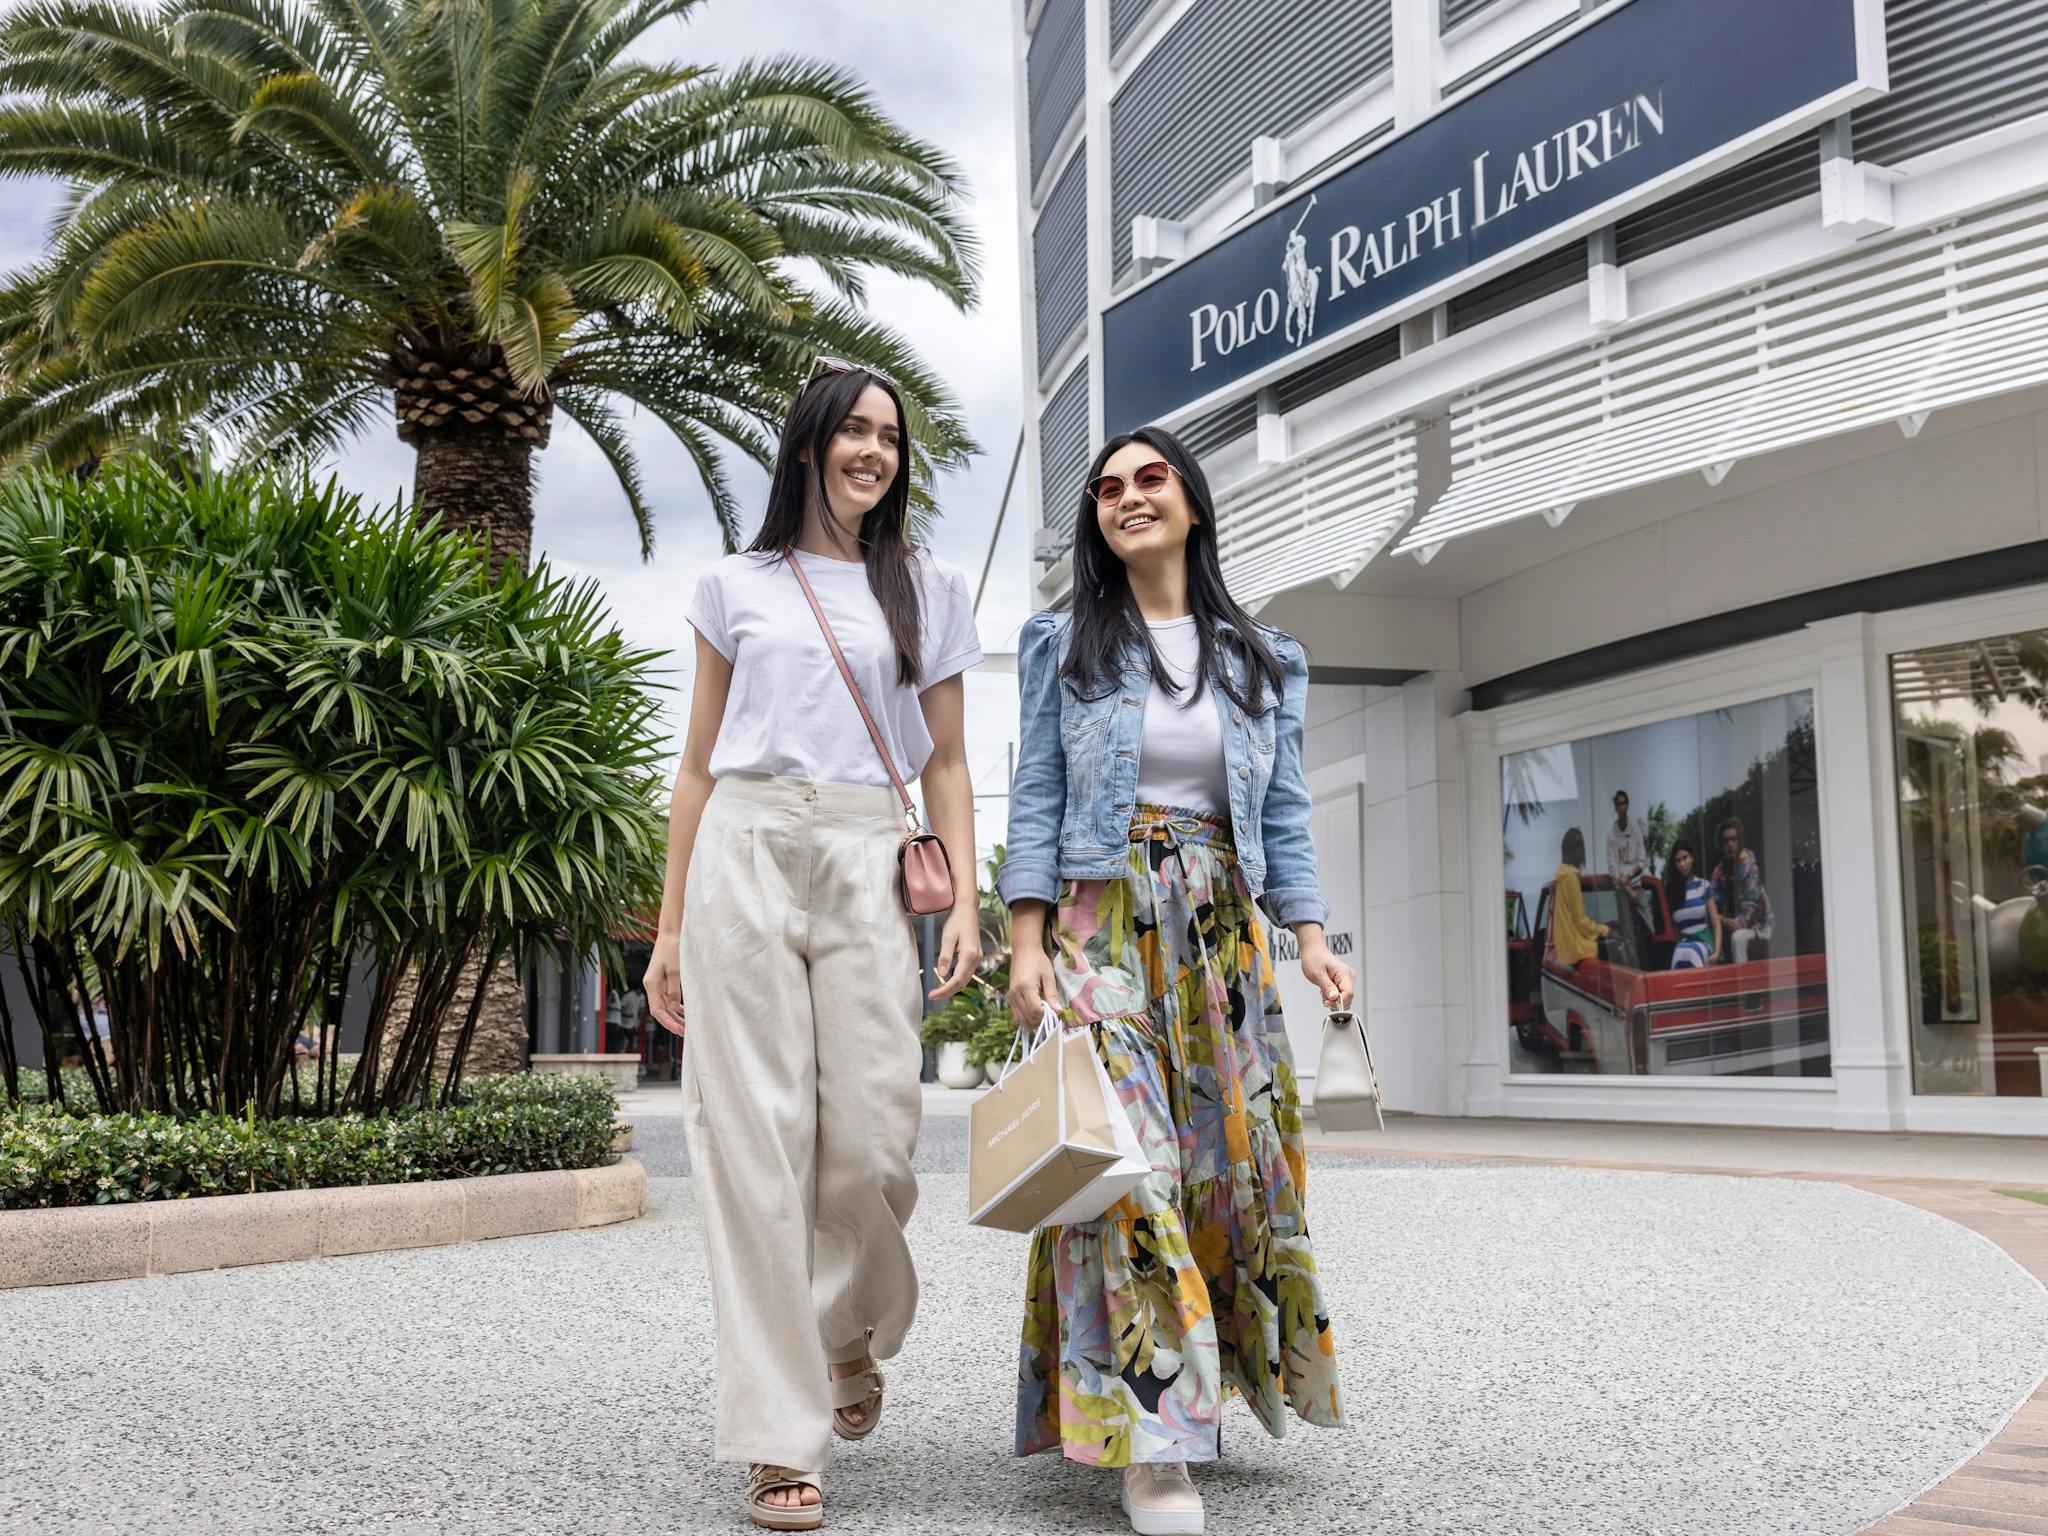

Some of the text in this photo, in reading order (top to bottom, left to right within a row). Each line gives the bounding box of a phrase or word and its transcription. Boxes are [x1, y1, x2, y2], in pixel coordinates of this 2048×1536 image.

[1189, 80, 1665, 372] POLO RALPH LAUREN
[1278, 933, 1301, 961] RAL
[987, 1097, 1041, 1149] MICHAEL KORS
